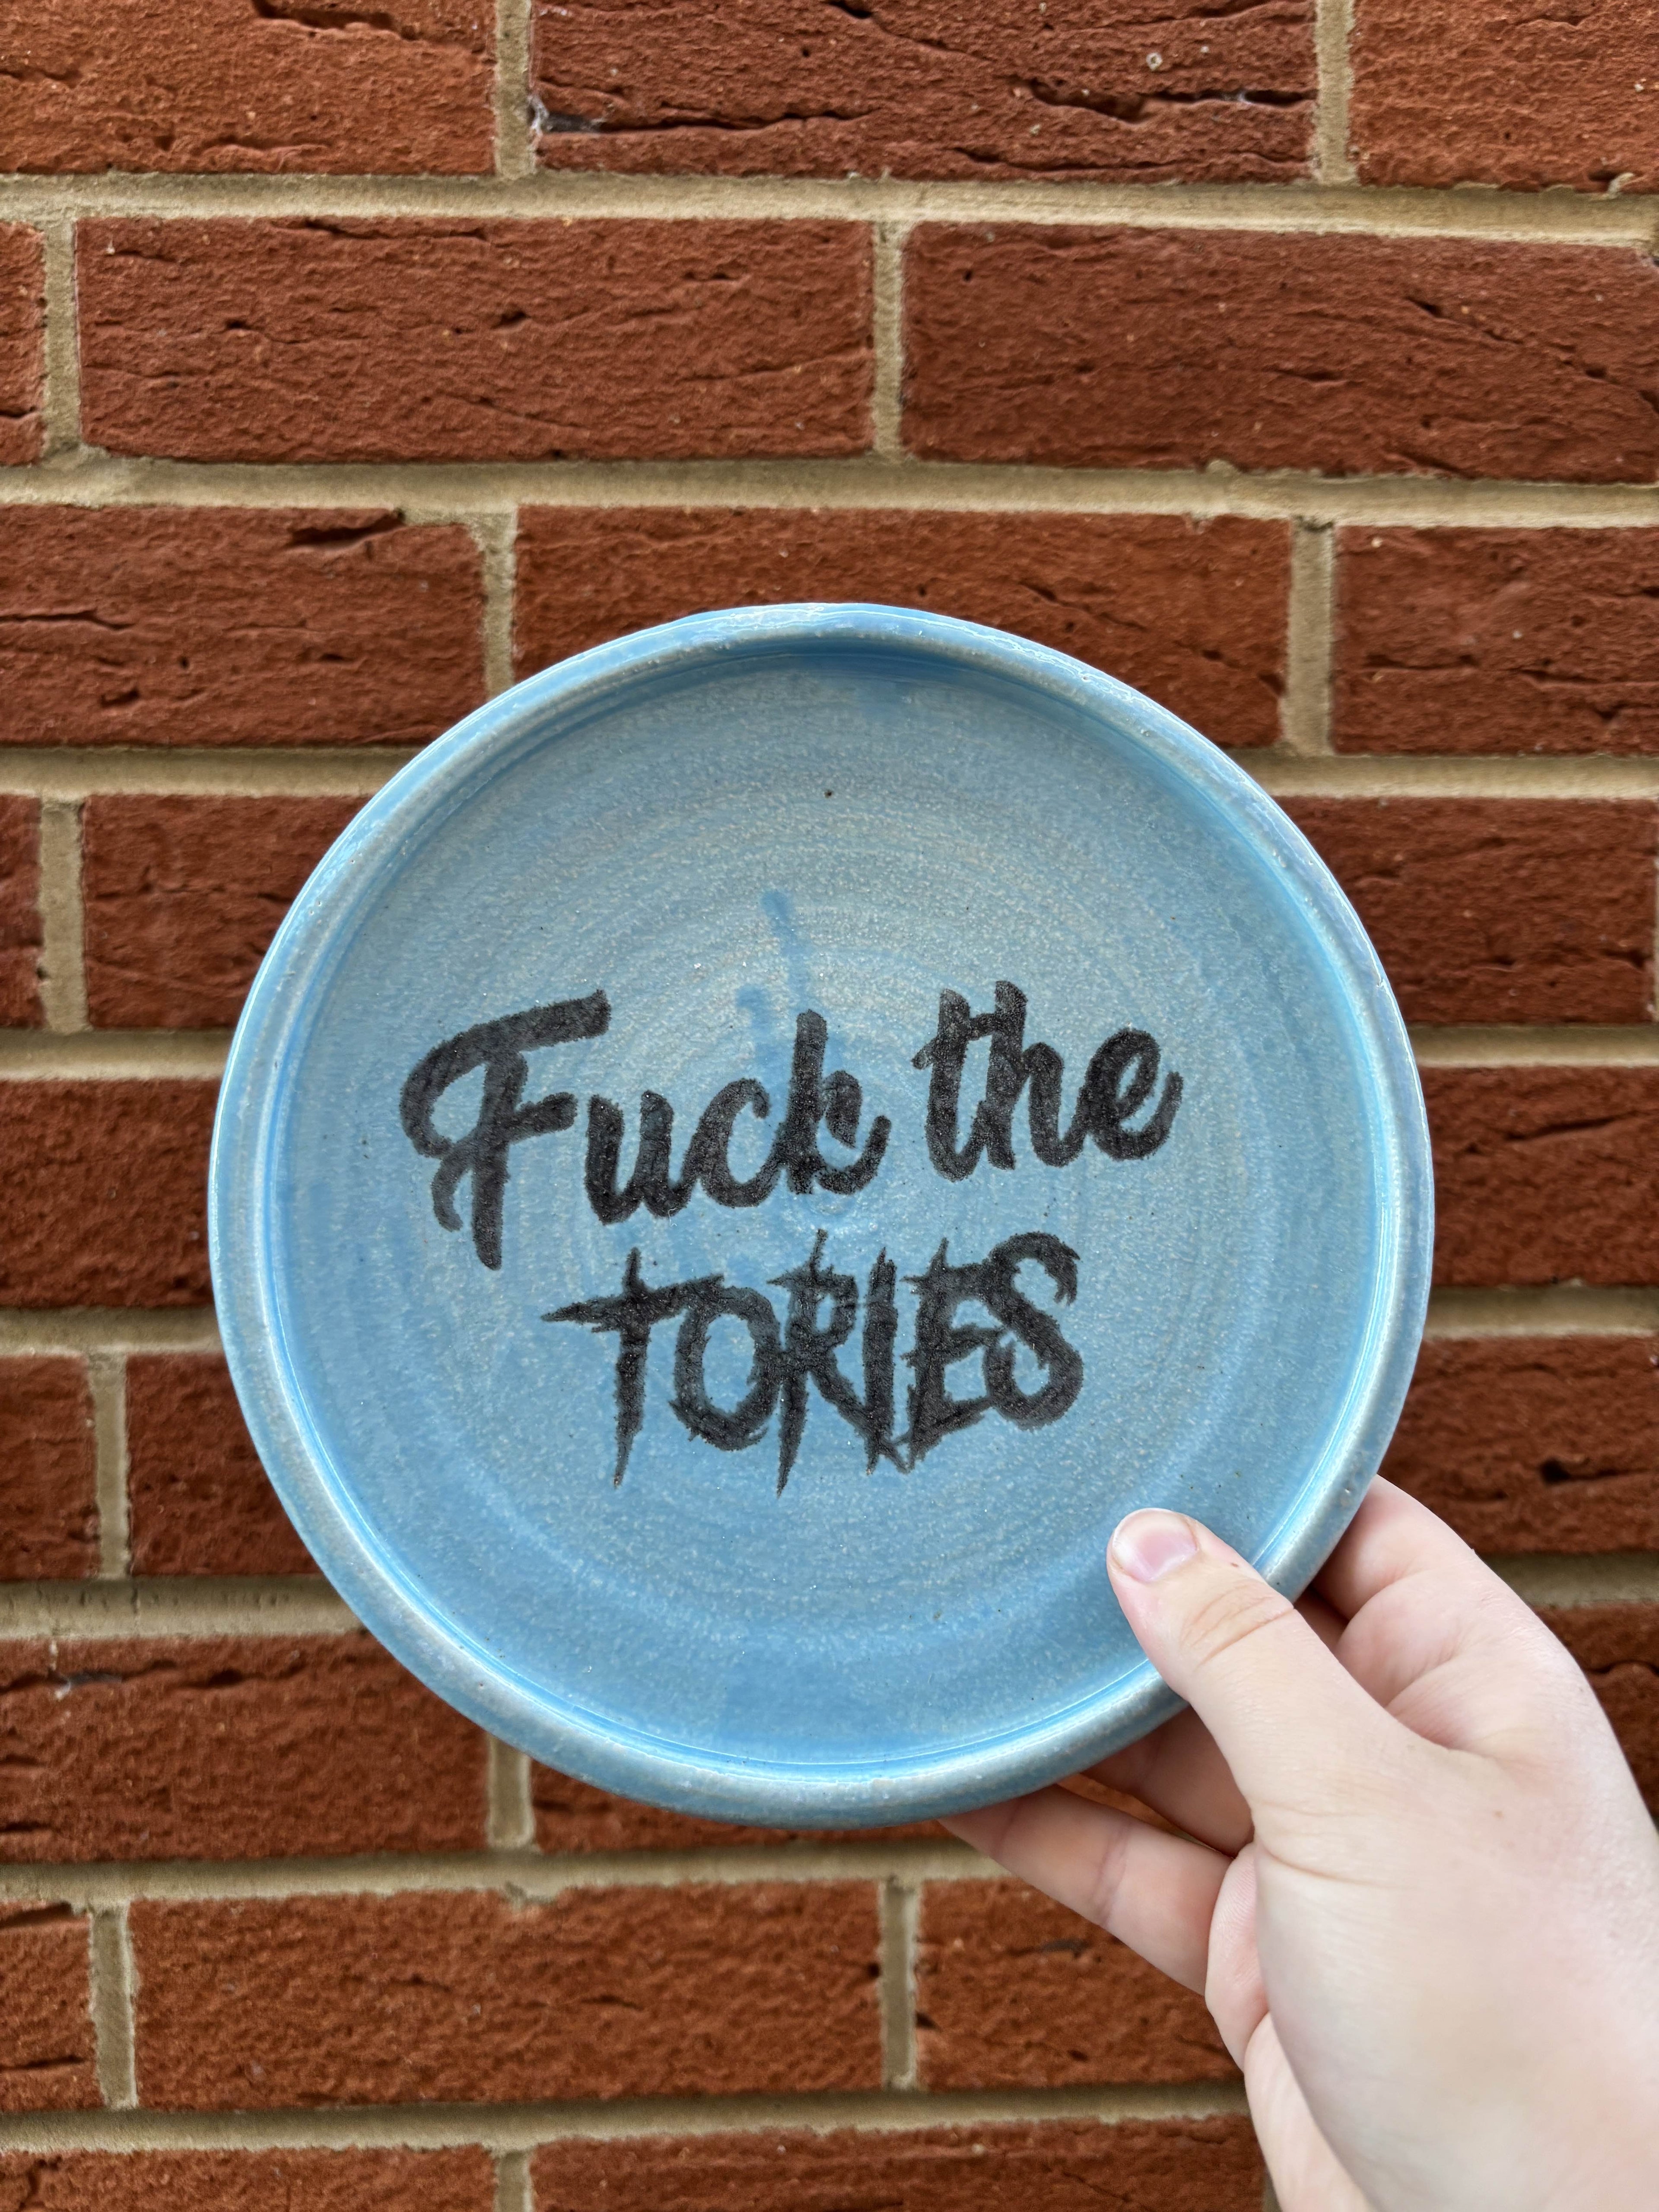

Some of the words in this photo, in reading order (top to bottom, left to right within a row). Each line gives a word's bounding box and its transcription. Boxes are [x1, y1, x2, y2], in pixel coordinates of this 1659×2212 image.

[400, 988, 891, 1270] Fuck
[912, 981, 1183, 1181] the
[541, 1230, 1082, 1495] TORIES
